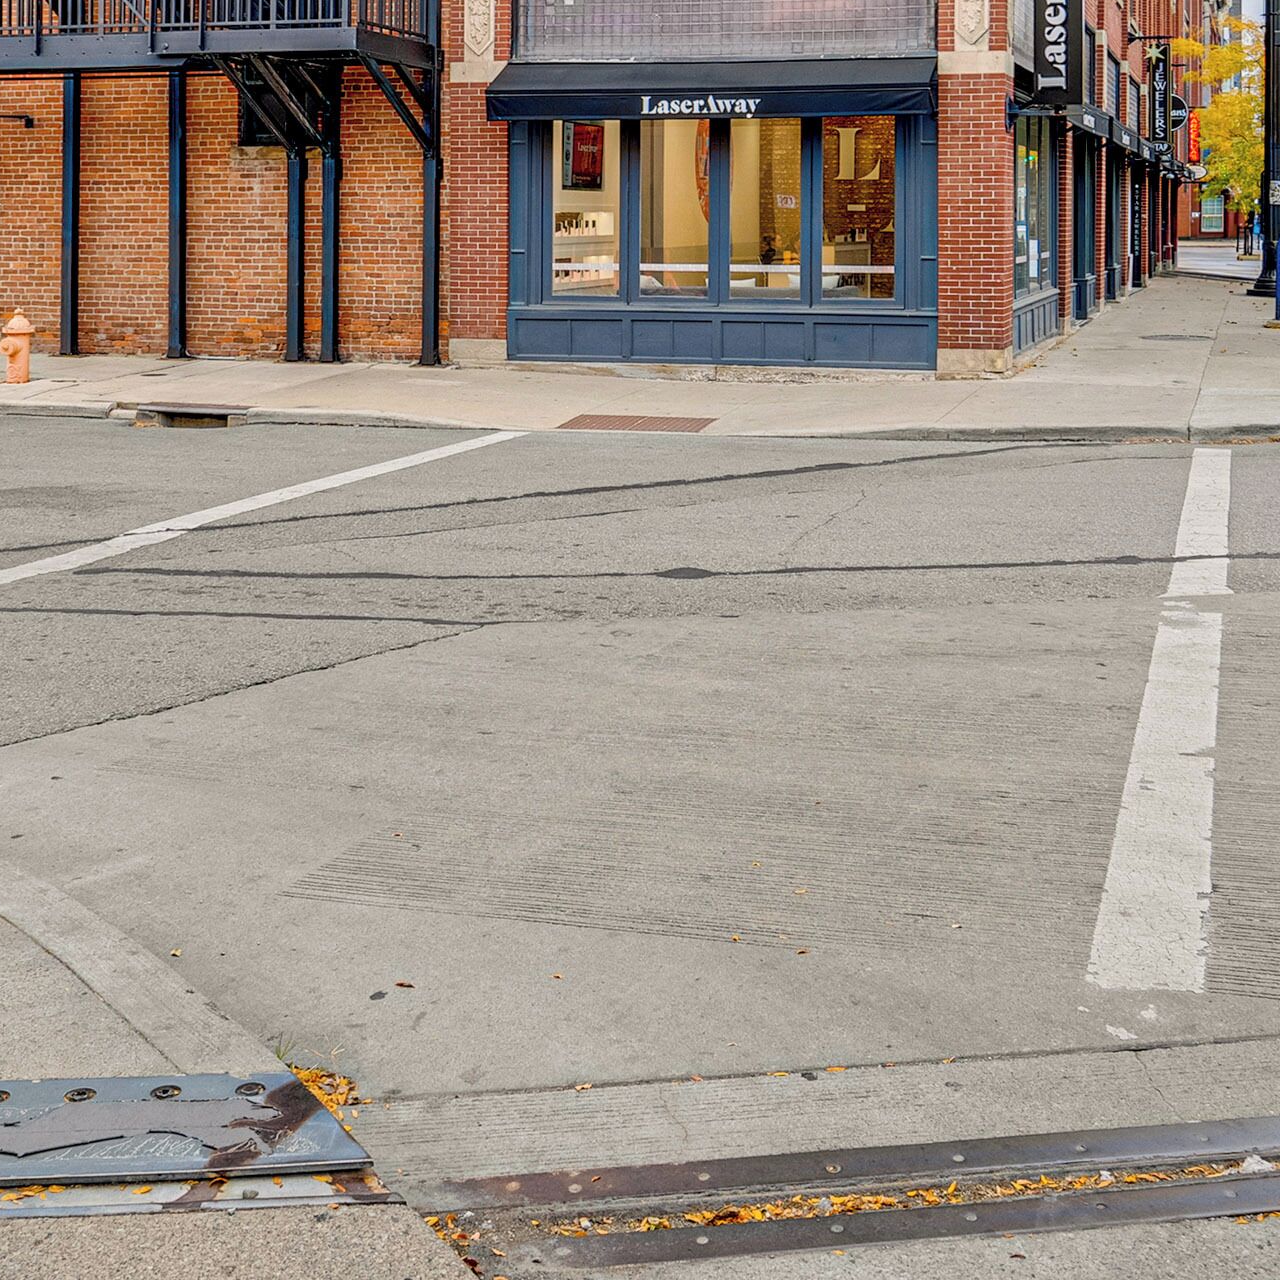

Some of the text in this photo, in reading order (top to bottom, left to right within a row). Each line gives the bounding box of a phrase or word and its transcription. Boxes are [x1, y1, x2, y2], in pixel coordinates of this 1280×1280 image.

[640, 95, 762, 119] LaserAway
[1153, 62, 1167, 138] JEWELERS
[833, 127, 881, 180] L
[1154, 143, 1168, 152] TAP
